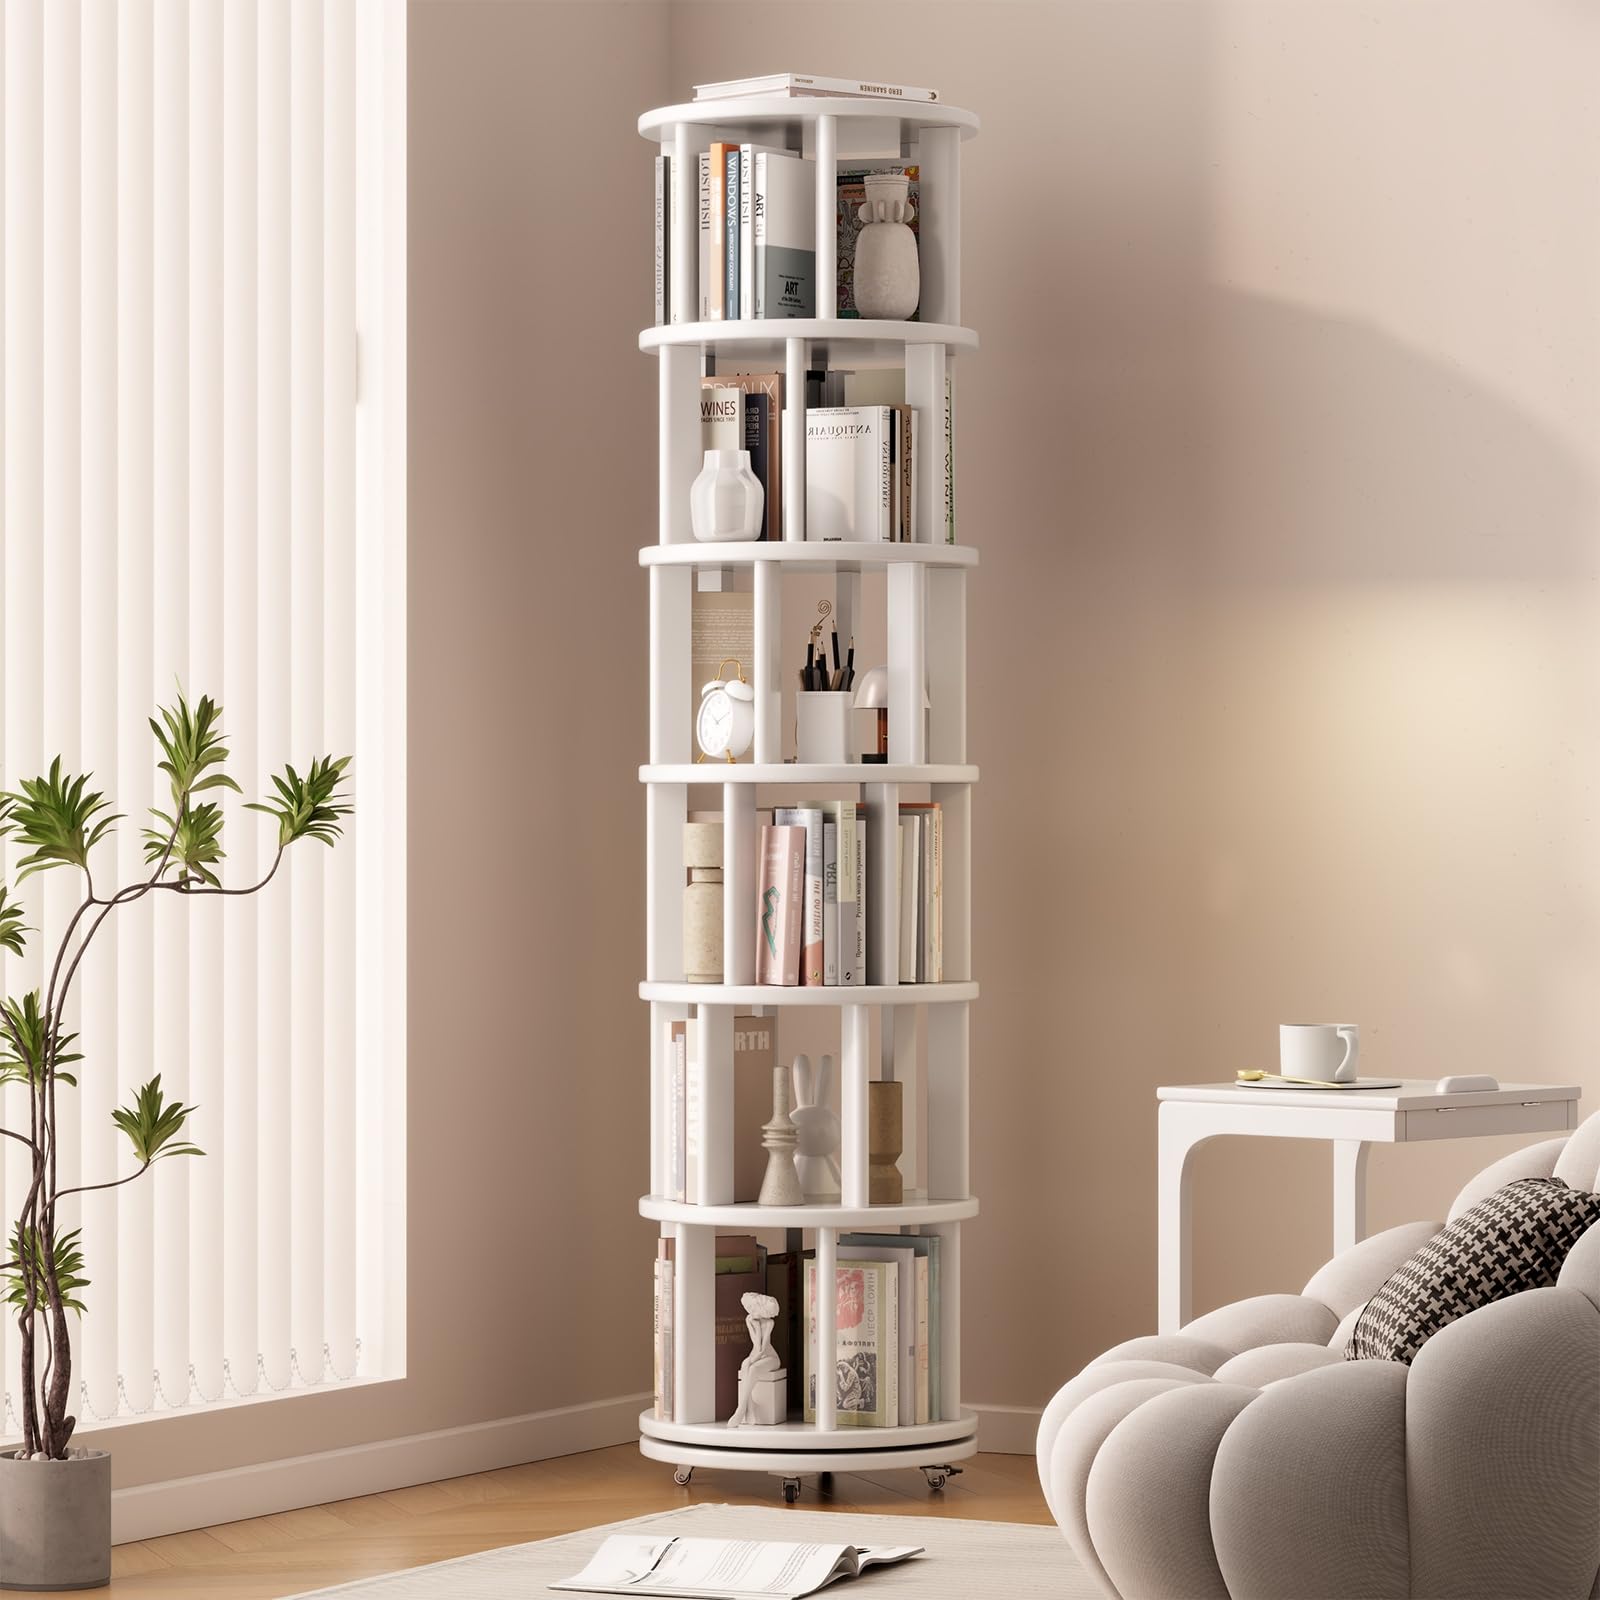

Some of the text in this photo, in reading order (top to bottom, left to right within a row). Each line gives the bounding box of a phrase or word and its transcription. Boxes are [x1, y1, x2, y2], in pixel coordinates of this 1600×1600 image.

[859, 84, 903, 96] EERO SAARINEN
[701, 157, 710, 230] LOST FISH
[728, 157, 737, 227] WINDOWS
[742, 149, 750, 225] LOST FISH
[755, 193, 764, 219] ART
[784, 280, 799, 295] ART
[700, 401, 736, 416] WINES
[735, 1031, 769, 1051] RTH
